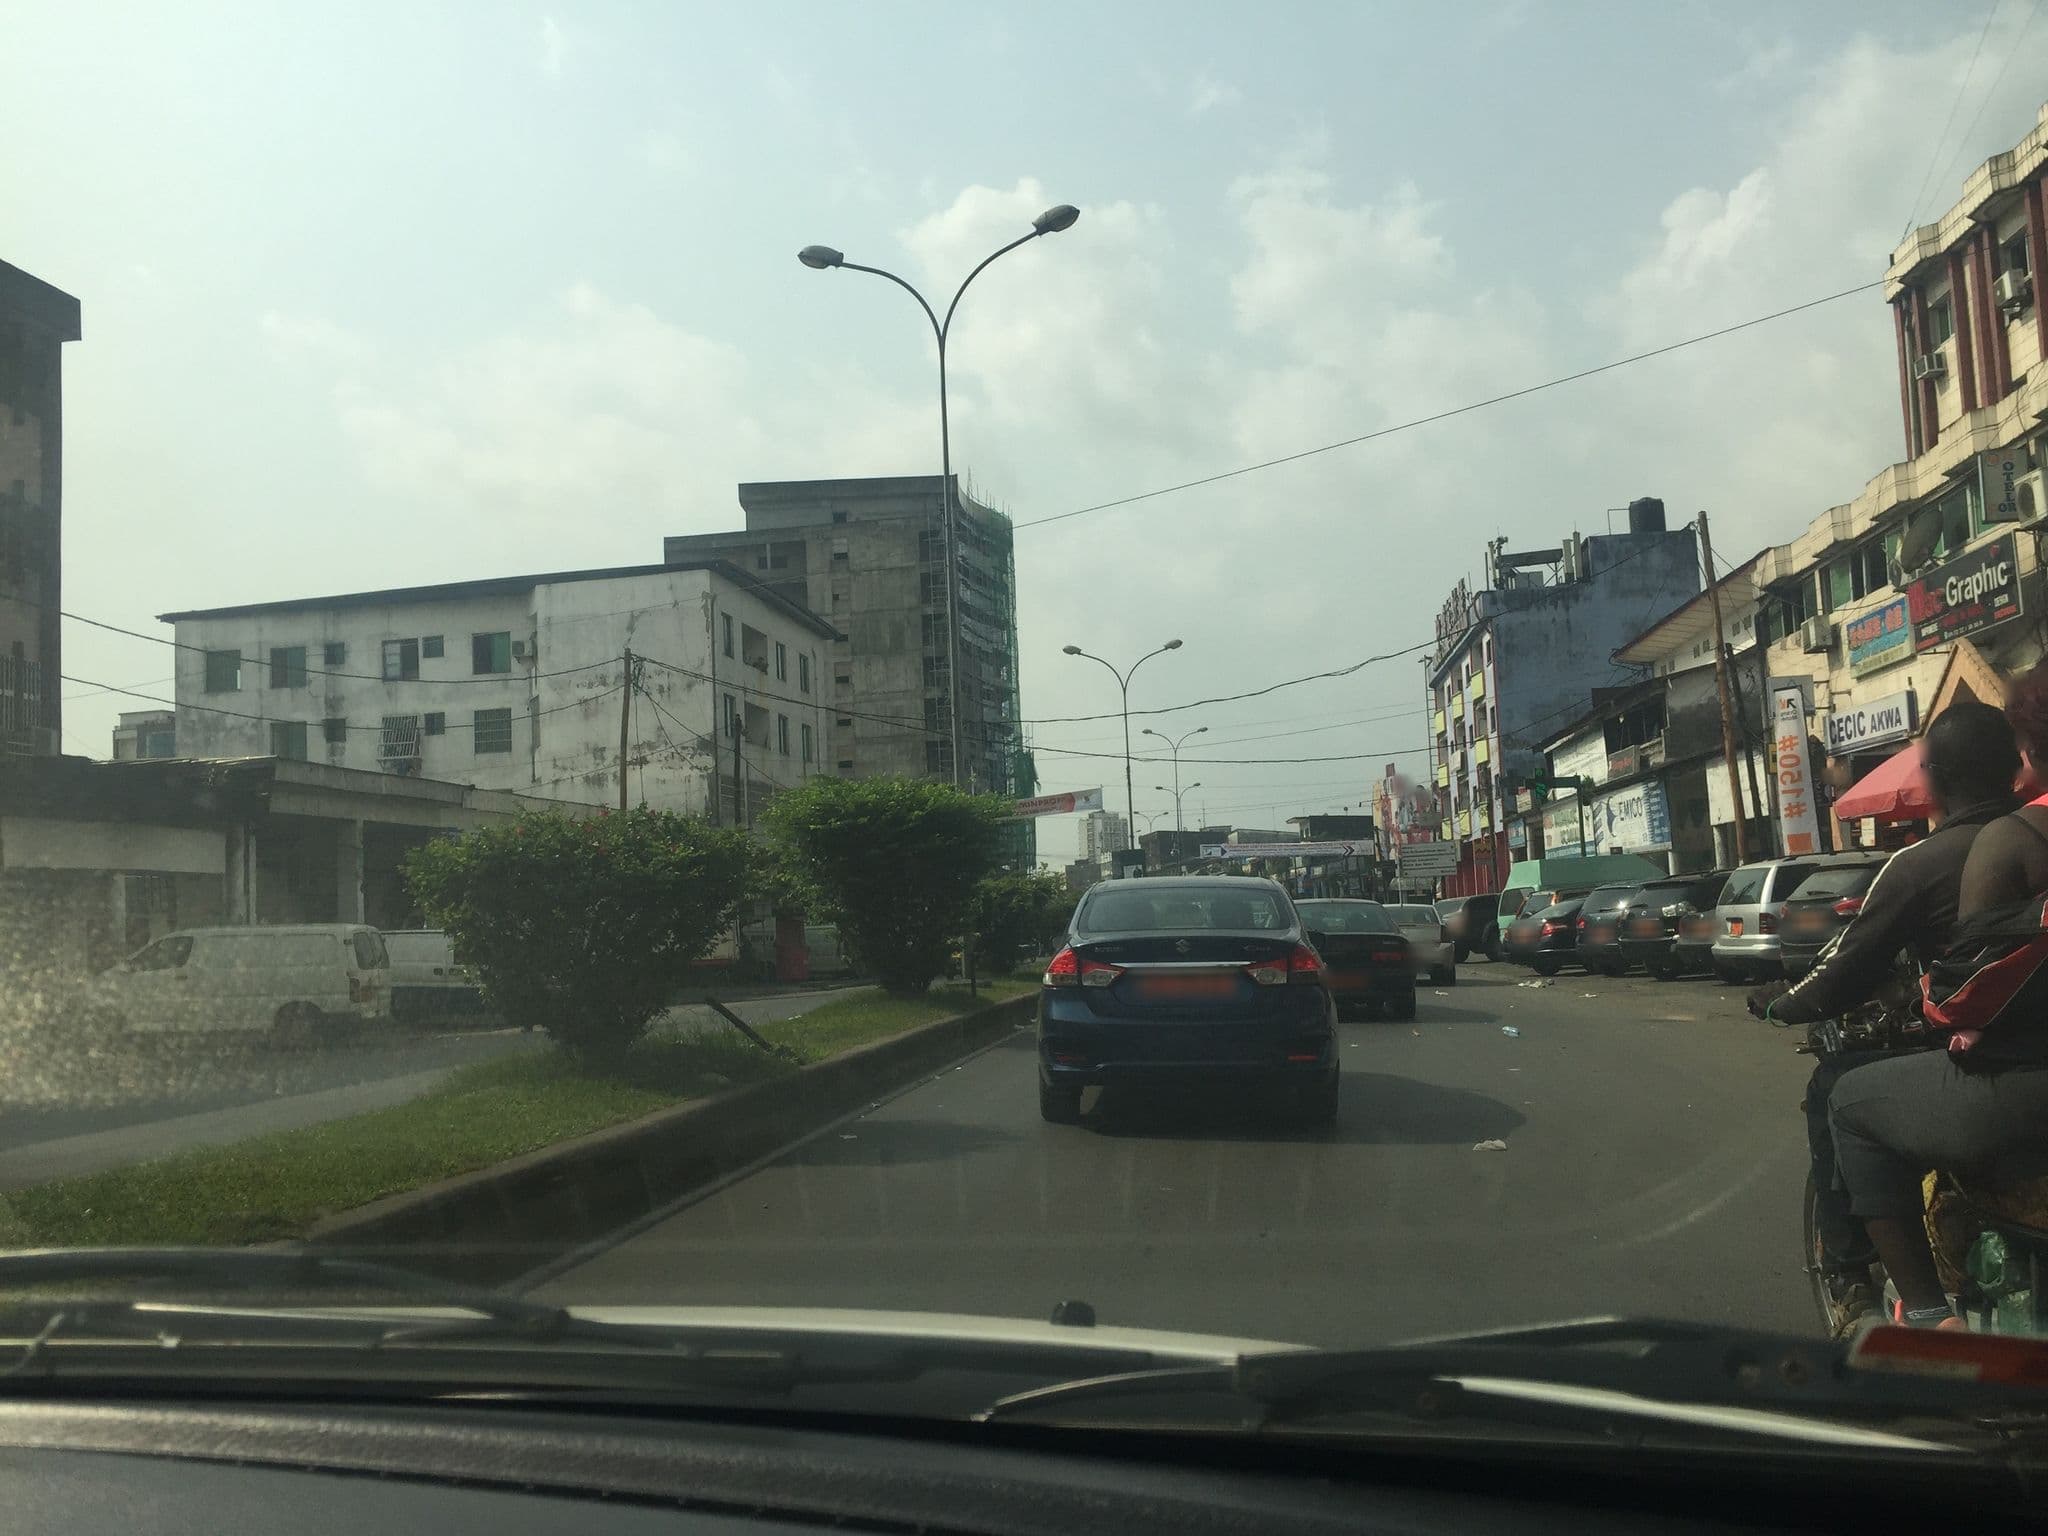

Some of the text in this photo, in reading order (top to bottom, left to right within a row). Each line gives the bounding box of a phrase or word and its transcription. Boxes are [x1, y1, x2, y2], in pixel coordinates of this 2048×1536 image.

[1945, 561, 2009, 607] Graphic
[1829, 706, 1902, 745] CECIC AKWA
